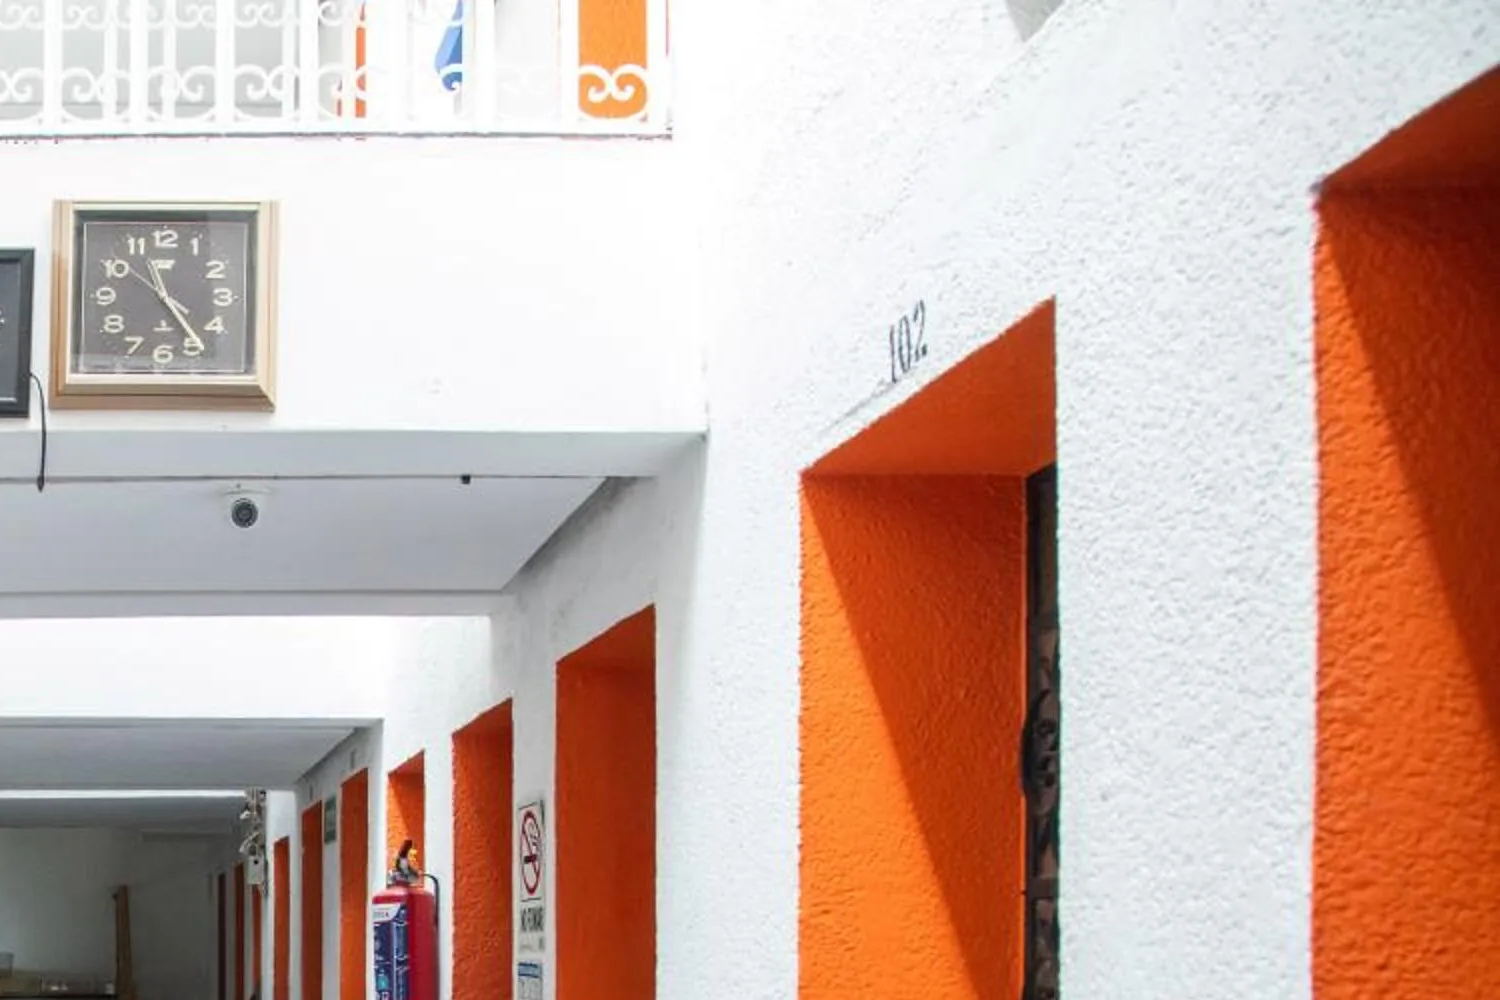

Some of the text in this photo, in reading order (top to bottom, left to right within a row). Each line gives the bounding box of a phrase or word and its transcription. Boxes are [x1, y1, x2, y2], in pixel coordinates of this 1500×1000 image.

[128, 237, 145, 255] 11
[151, 229, 178, 248] 12
[190, 237, 199, 256] 1
[103, 259, 129, 278] 10
[205, 260, 226, 279] 2
[96, 287, 116, 305] 9
[213, 287, 233, 306] 3
[103, 314, 124, 333] 8
[203, 316, 225, 334] 4
[124, 336, 144, 355] 7
[183, 337, 201, 356] 5
[889, 299, 928, 384] 102
[153, 345, 174, 363] 6
